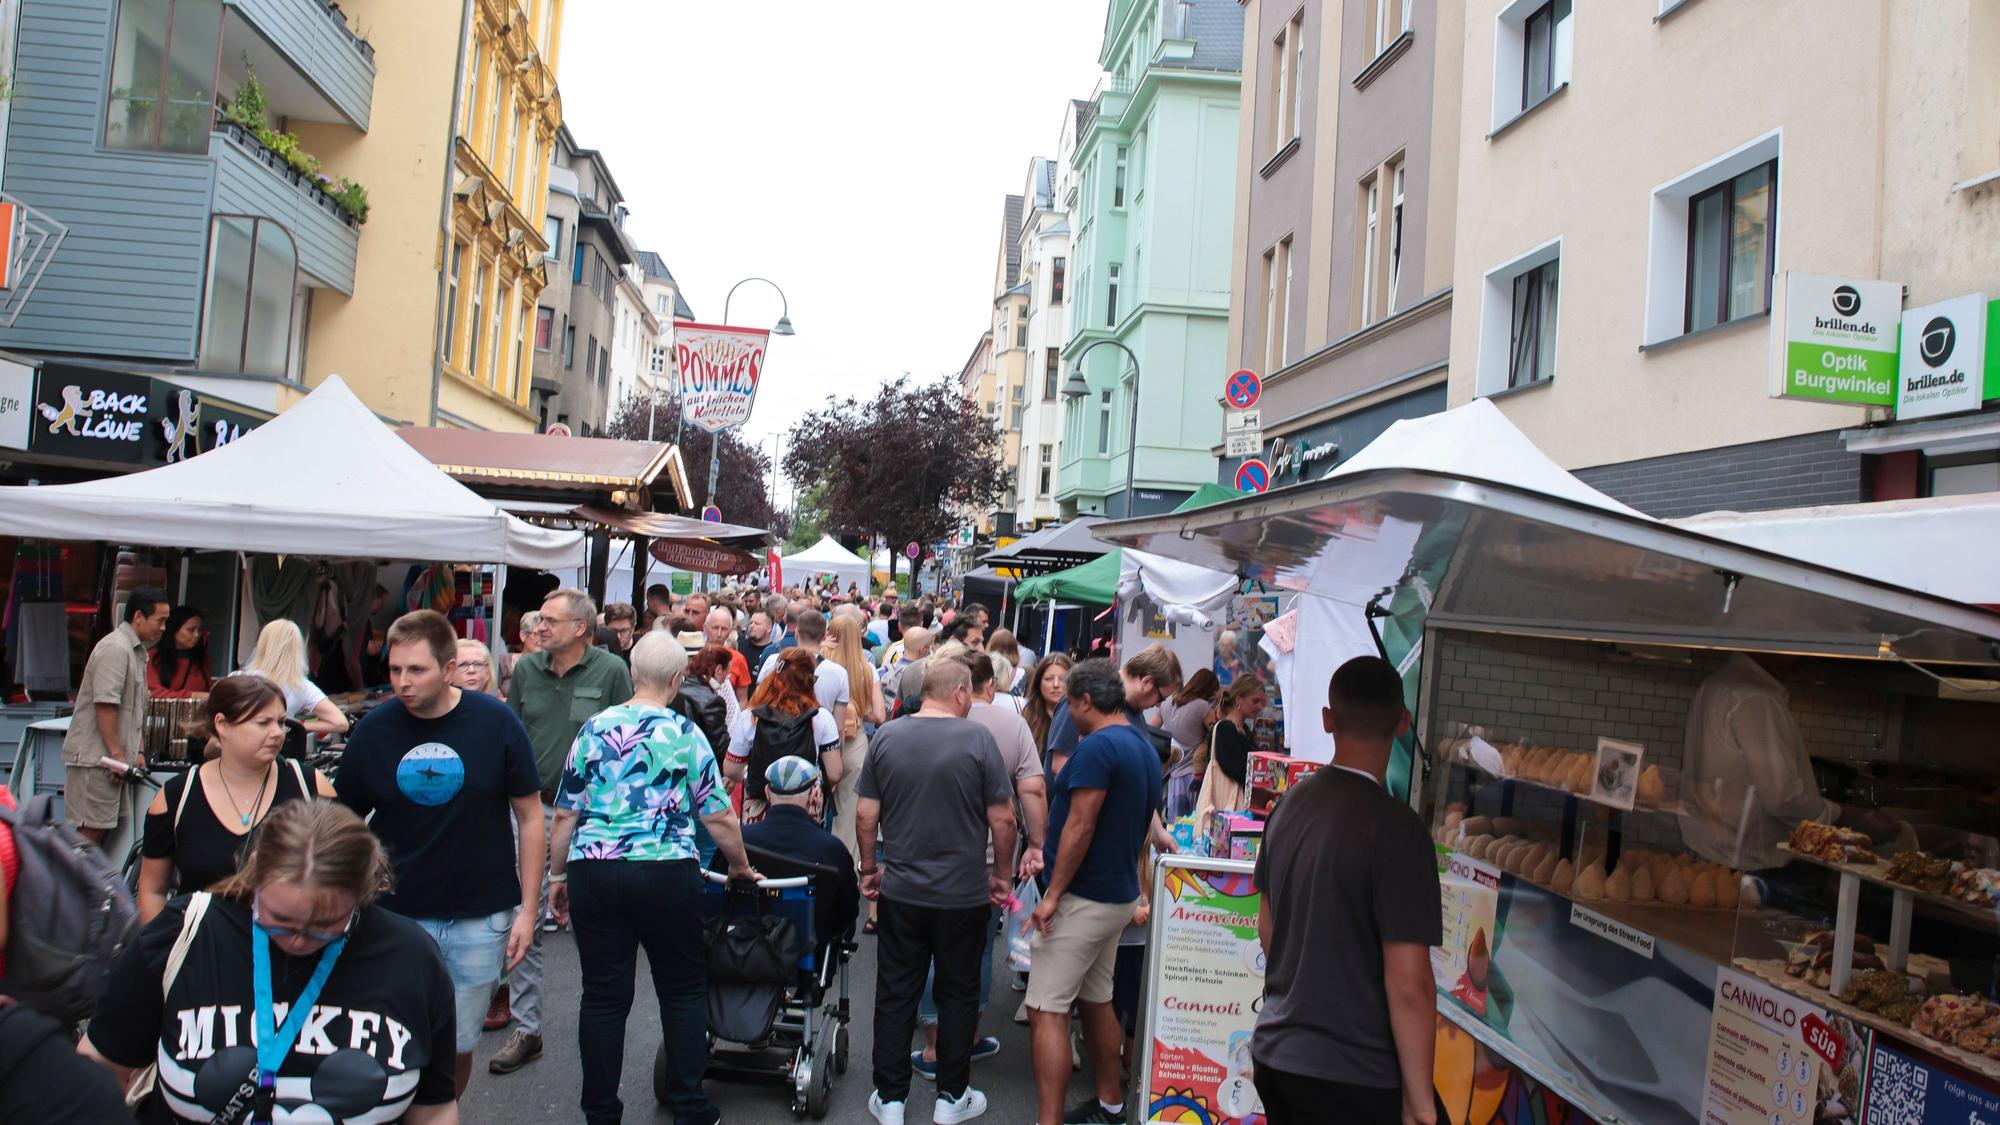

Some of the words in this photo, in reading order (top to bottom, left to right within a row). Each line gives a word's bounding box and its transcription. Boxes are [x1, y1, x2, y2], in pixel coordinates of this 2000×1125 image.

[1815, 316, 1876, 335] brillen.de
[678, 343, 762, 395] POMMES
[1822, 351, 1868, 373] Optik
[1795, 369, 1891, 396] Burgwinkel
[1907, 369, 1965, 392] brillen.de
[91, 389, 148, 414] BACK
[686, 395, 704, 406] aus
[706, 394, 745, 407] frischen
[1903, 394, 1915, 404] Die
[1916, 390, 1941, 402] lokalen
[1941, 386, 1969, 398] Optiker
[694, 405, 745, 418] Kartoffeln
[81, 414, 144, 441] LÖWE
[1170, 905, 1260, 928] Arancini
[1583, 912, 1608, 933] Ursprung
[1214, 969, 1249, 978] Schinken
[1164, 996, 1242, 1015] Cannoli
[1721, 981, 1796, 1028] CANNOLO
[1944, 1080, 1966, 1097] Folge
[1967, 1092, 1982, 1105] uns
[1984, 1100, 1999, 1112] auf
